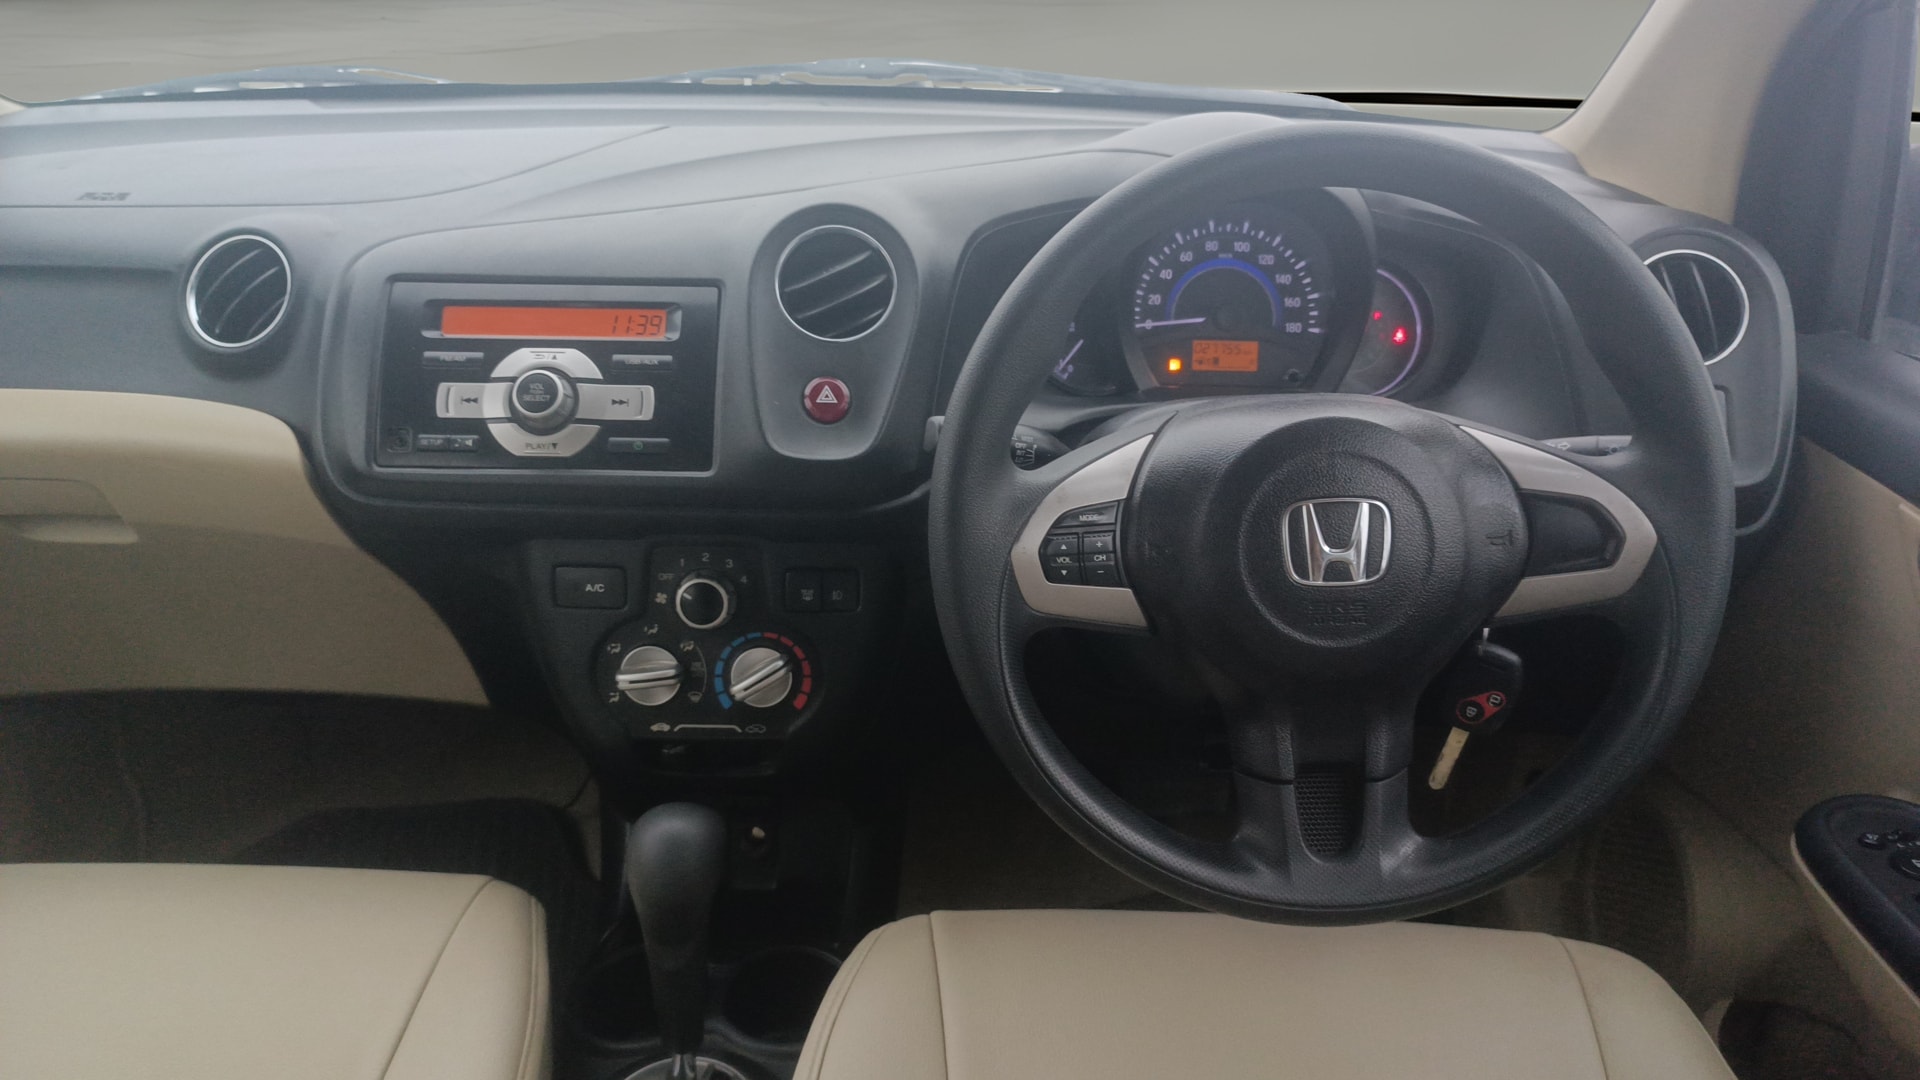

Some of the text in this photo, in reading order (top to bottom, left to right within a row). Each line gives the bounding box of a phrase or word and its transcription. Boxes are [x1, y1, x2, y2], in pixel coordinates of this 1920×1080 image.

[1204, 240, 1219, 252] 80
[1233, 241, 1251, 253] 100
[1179, 250, 1193, 263] 60
[1258, 254, 1275, 265] 120
[1159, 268, 1173, 280] 40
[1275, 273, 1292, 285] 140
[1148, 293, 1162, 305] 20
[1284, 296, 1302, 308] 160
[611, 314, 664, 336] 11:39
[1285, 322, 1303, 333] 180
[522, 394, 551, 402] SELECT
[701, 552, 710, 562] 2
[1055, 555, 1073, 564] VOL
[1093, 553, 1107, 562] CH
[679, 558, 685, 568] 1
[725, 558, 734, 569] 3
[739, 575, 748, 585] 4
[584, 583, 606, 593] A/C
